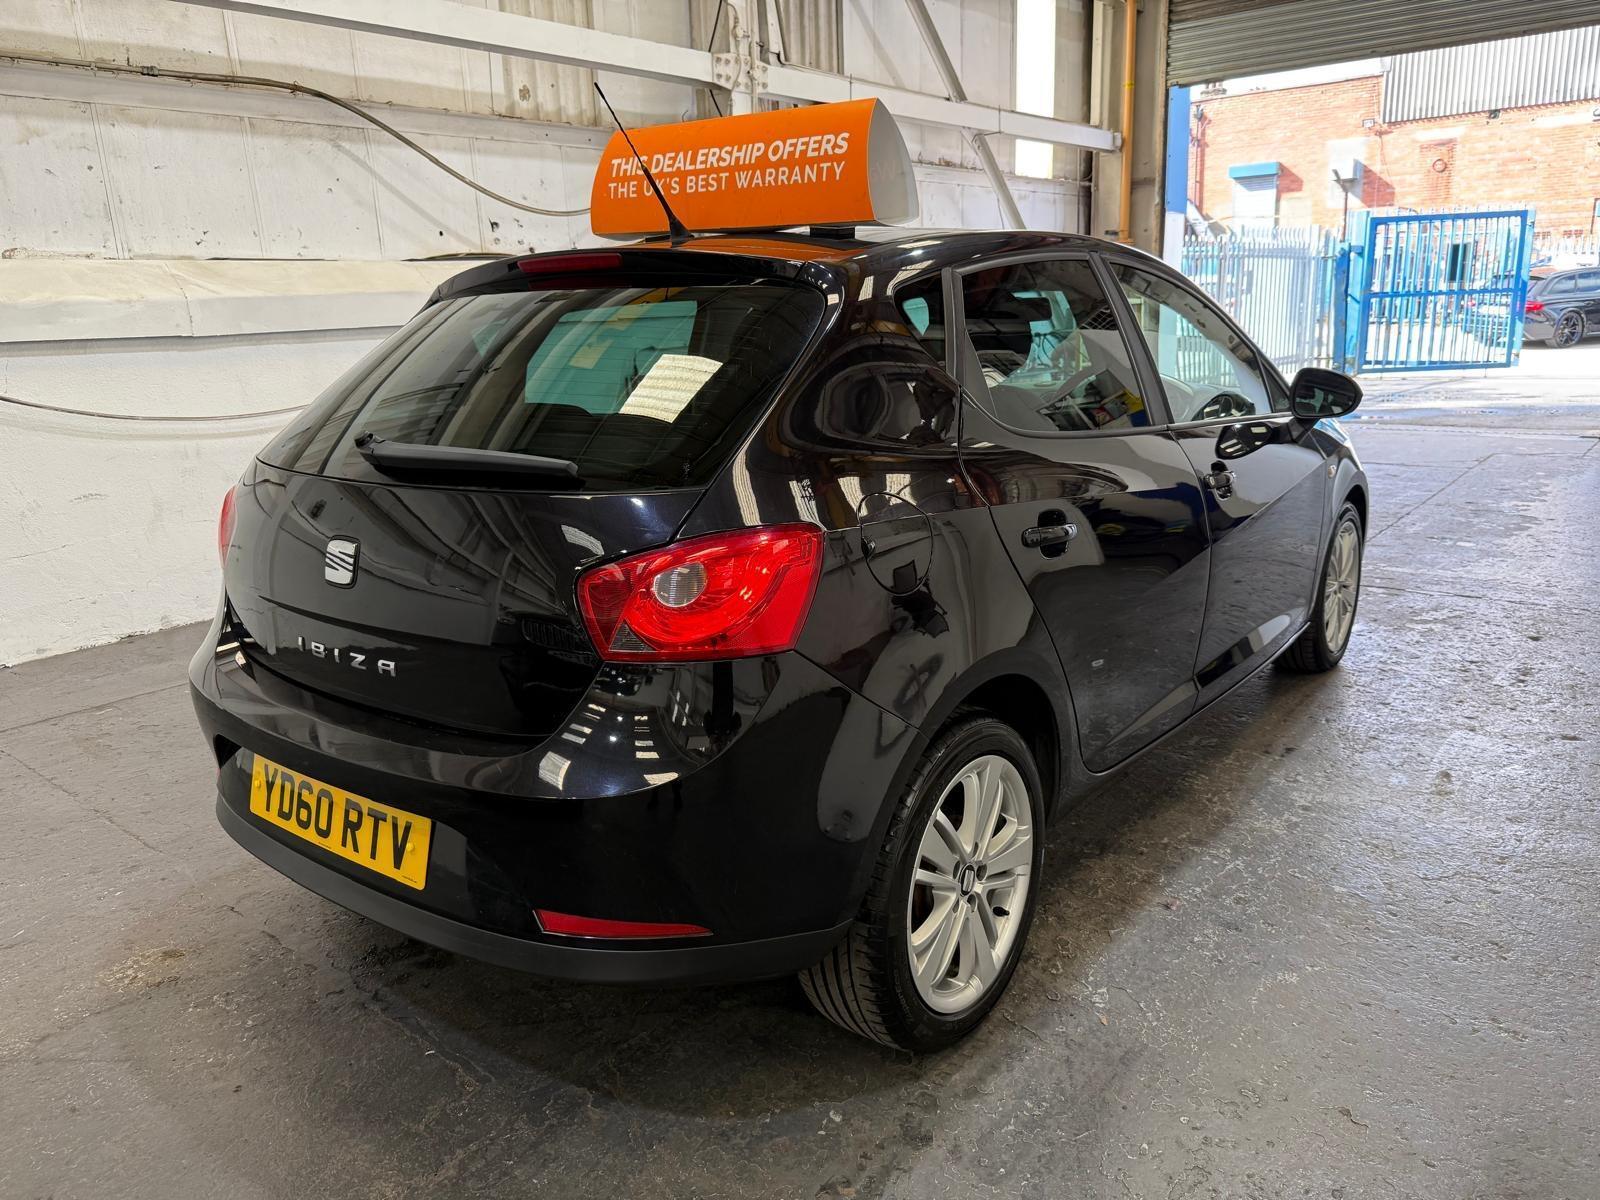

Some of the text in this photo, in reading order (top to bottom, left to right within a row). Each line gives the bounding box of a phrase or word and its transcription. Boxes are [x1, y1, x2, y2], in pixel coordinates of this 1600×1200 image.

[611, 132, 850, 177] THIS DEALERSHIP OFFERS
[608, 181, 638, 199] THE
[643, 177, 680, 197] UK'S
[686, 172, 729, 194] BEST
[735, 161, 846, 189] WARRANTY
[297, 636, 397, 677] IBIZA
[263, 763, 413, 871] YD60 RTV
